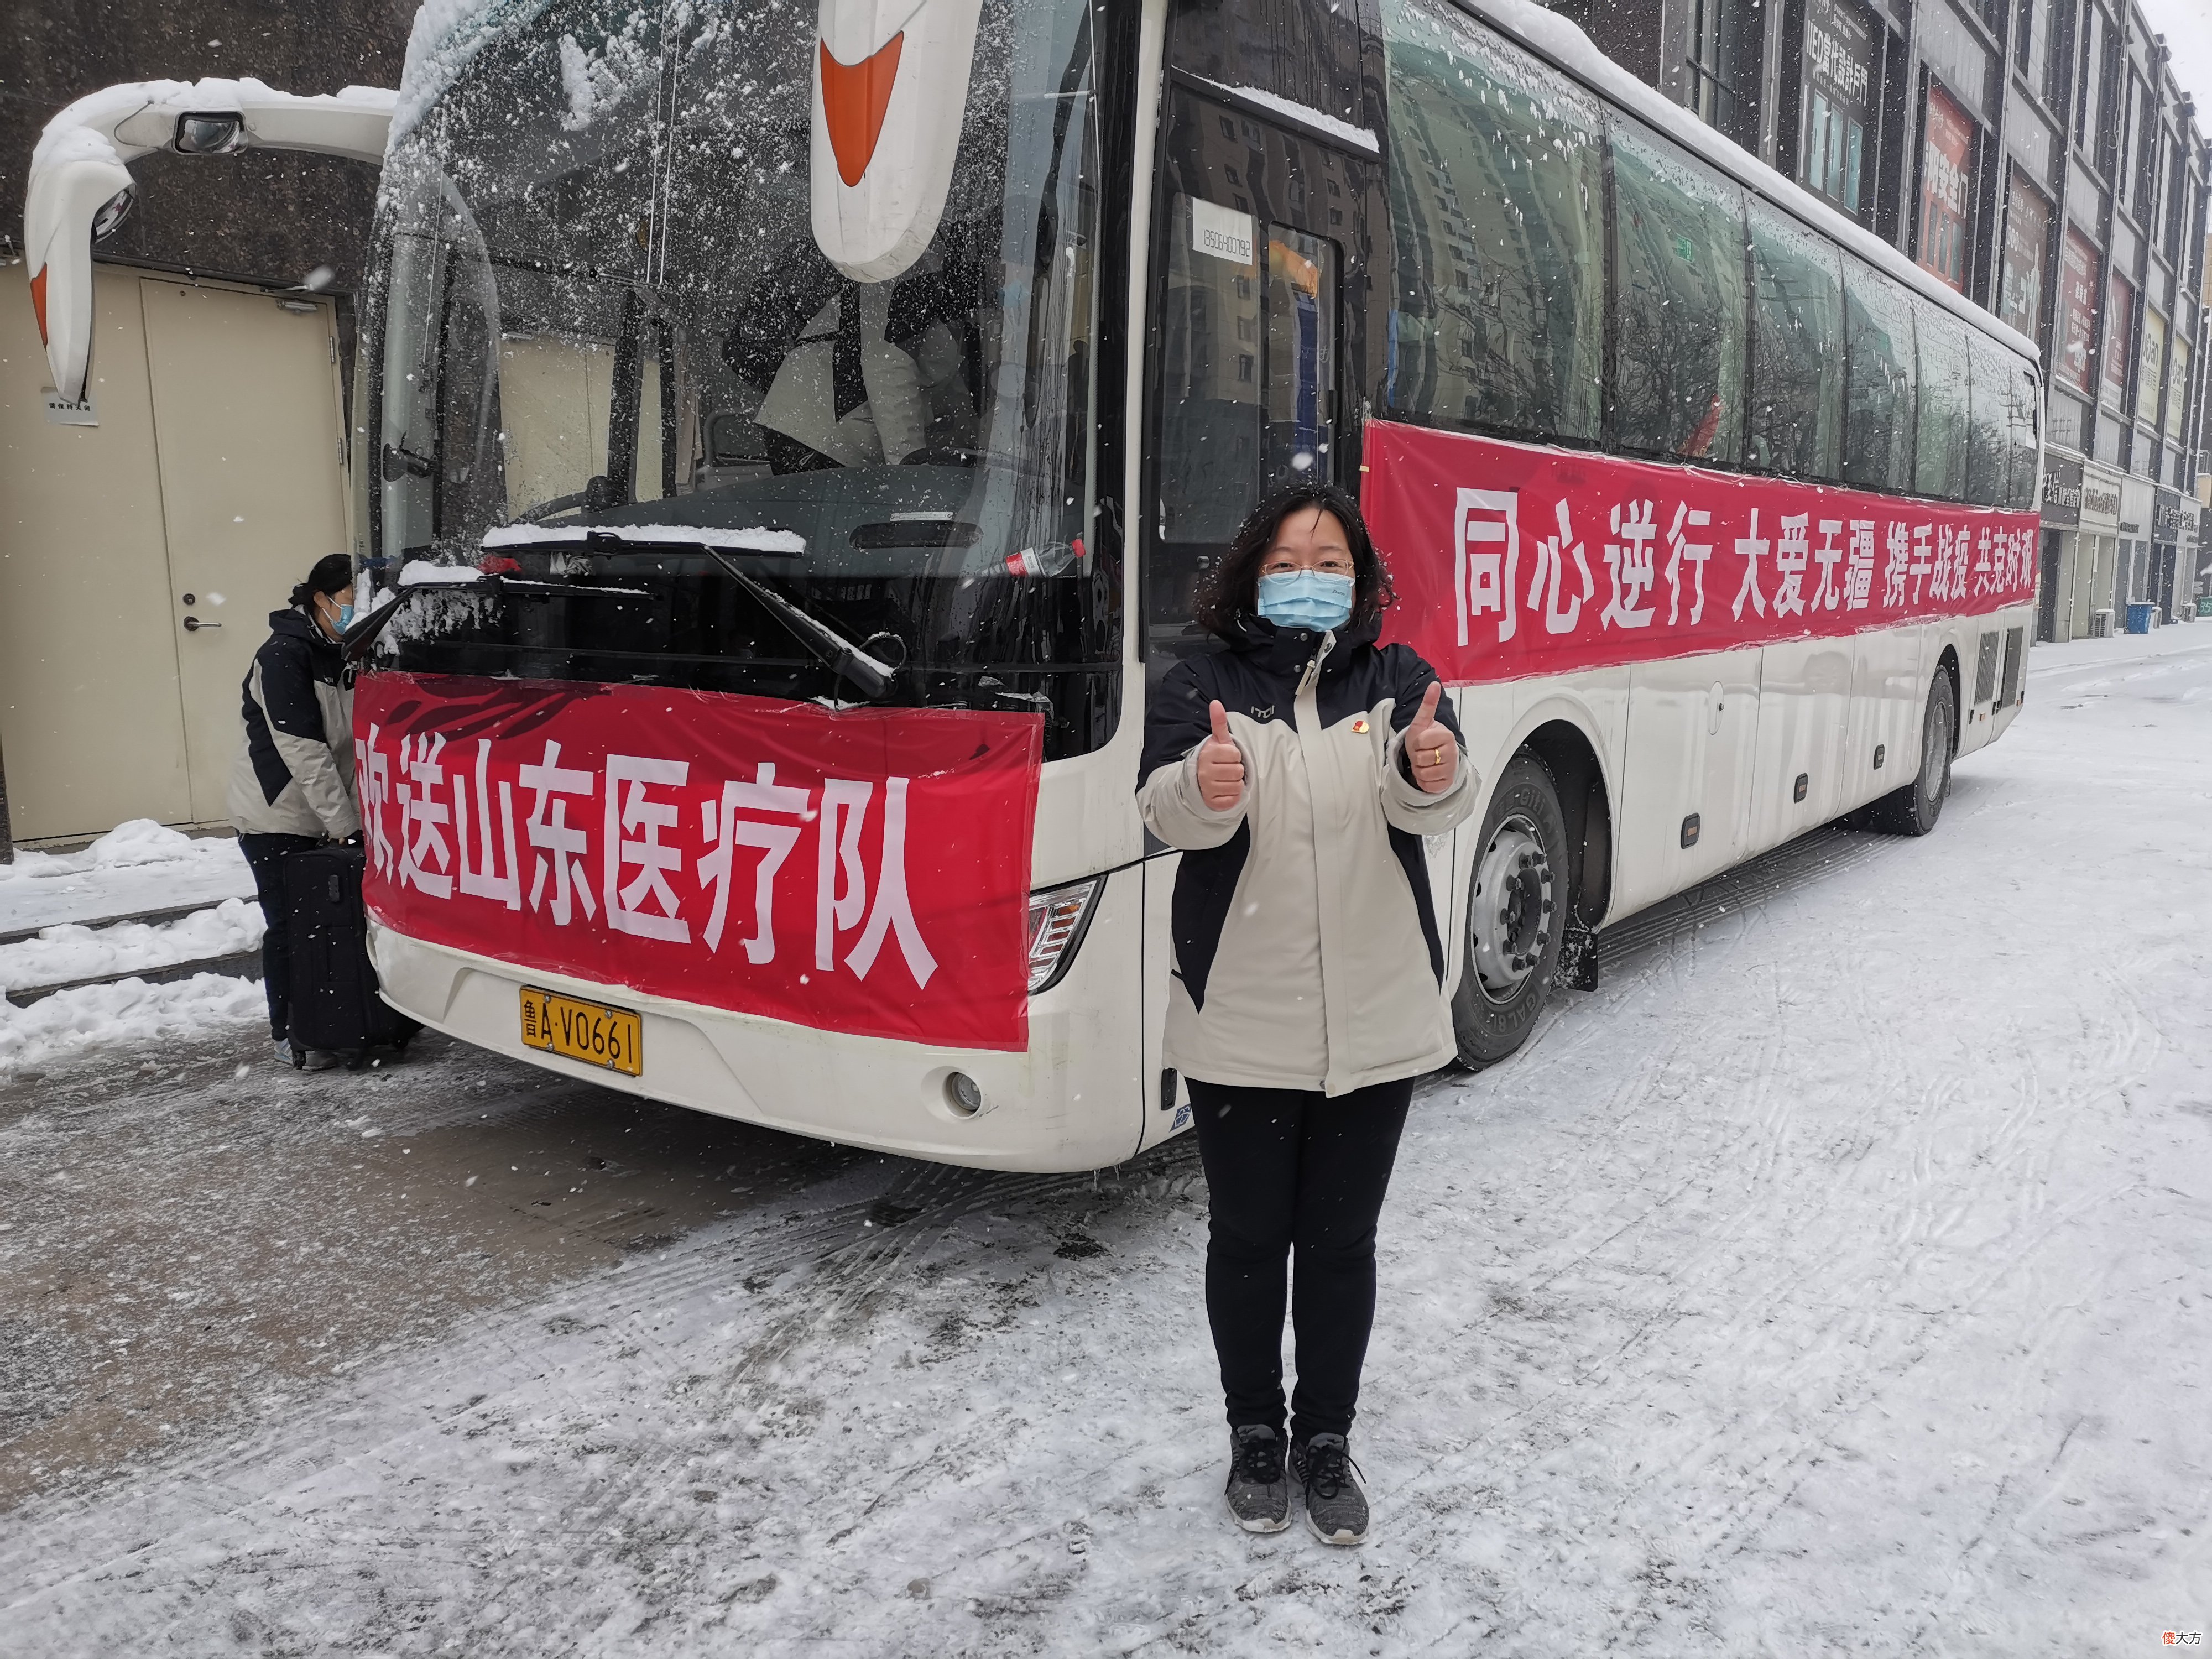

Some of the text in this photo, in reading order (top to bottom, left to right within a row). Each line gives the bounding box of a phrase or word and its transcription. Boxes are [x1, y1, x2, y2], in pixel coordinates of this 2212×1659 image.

[1203, 229, 1250, 257] 13506400792
[1456, 487, 2034, 646] 同心逆行 大爱无疆 携手战疫 共克时艰
[1520, 787, 1546, 815] Giti
[355, 722, 938, 990] 欢送山东医疗队
